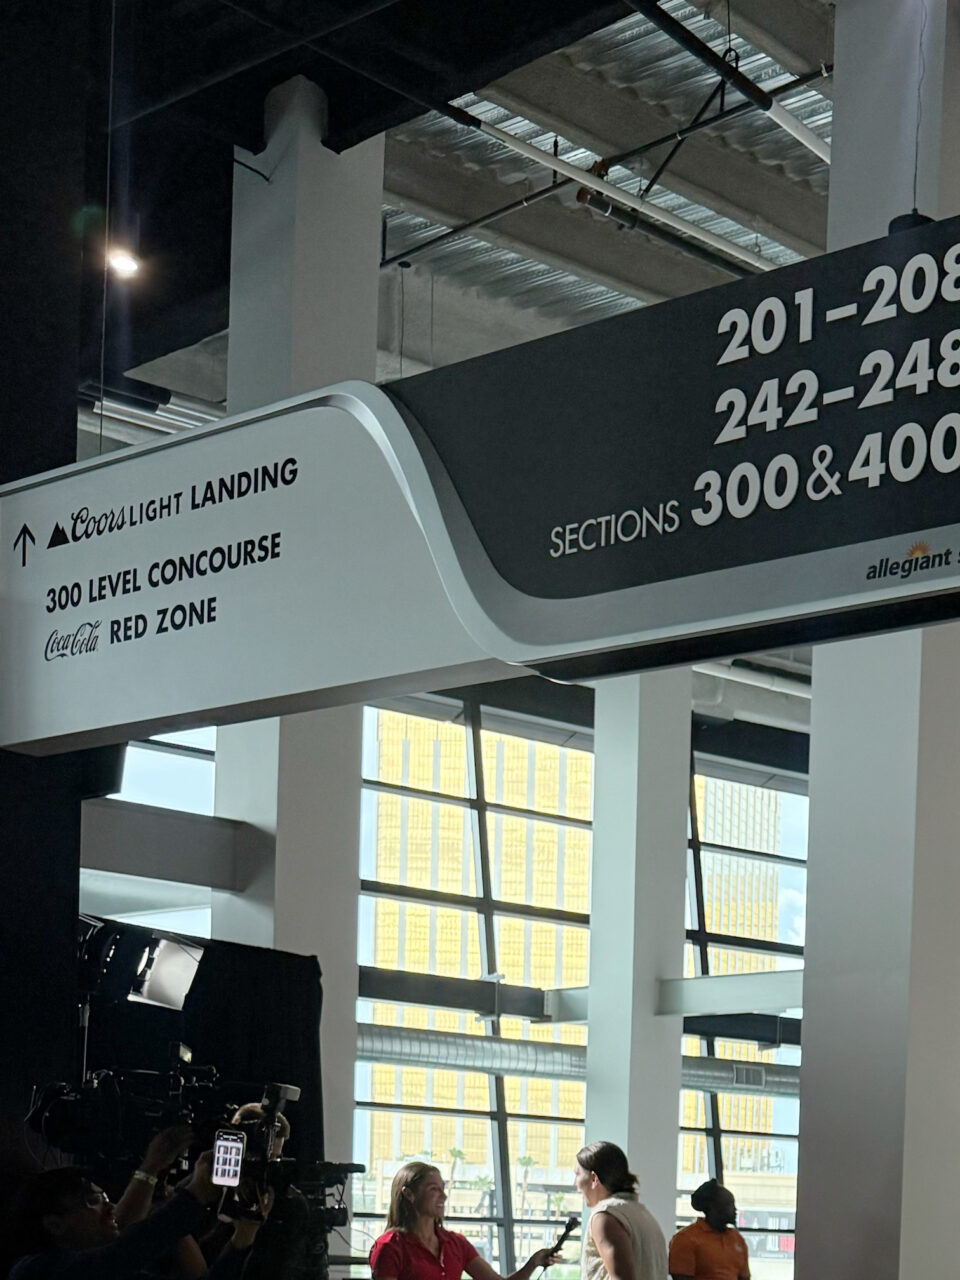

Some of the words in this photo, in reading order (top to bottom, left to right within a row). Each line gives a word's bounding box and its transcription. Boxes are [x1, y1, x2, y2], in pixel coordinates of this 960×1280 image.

[71, 507, 127, 543] Coors
[129, 491, 183, 527] LIGHT
[190, 457, 298, 511] LANDING
[549, 500, 680, 558] SECTIONS
[46, 582, 82, 614] 300
[89, 568, 141, 603] LEVEL
[148, 532, 281, 588] CONCOURSE
[866, 549, 952, 580] allegiant
[110, 614, 147, 645] RED
[156, 597, 217, 634] ZONE
